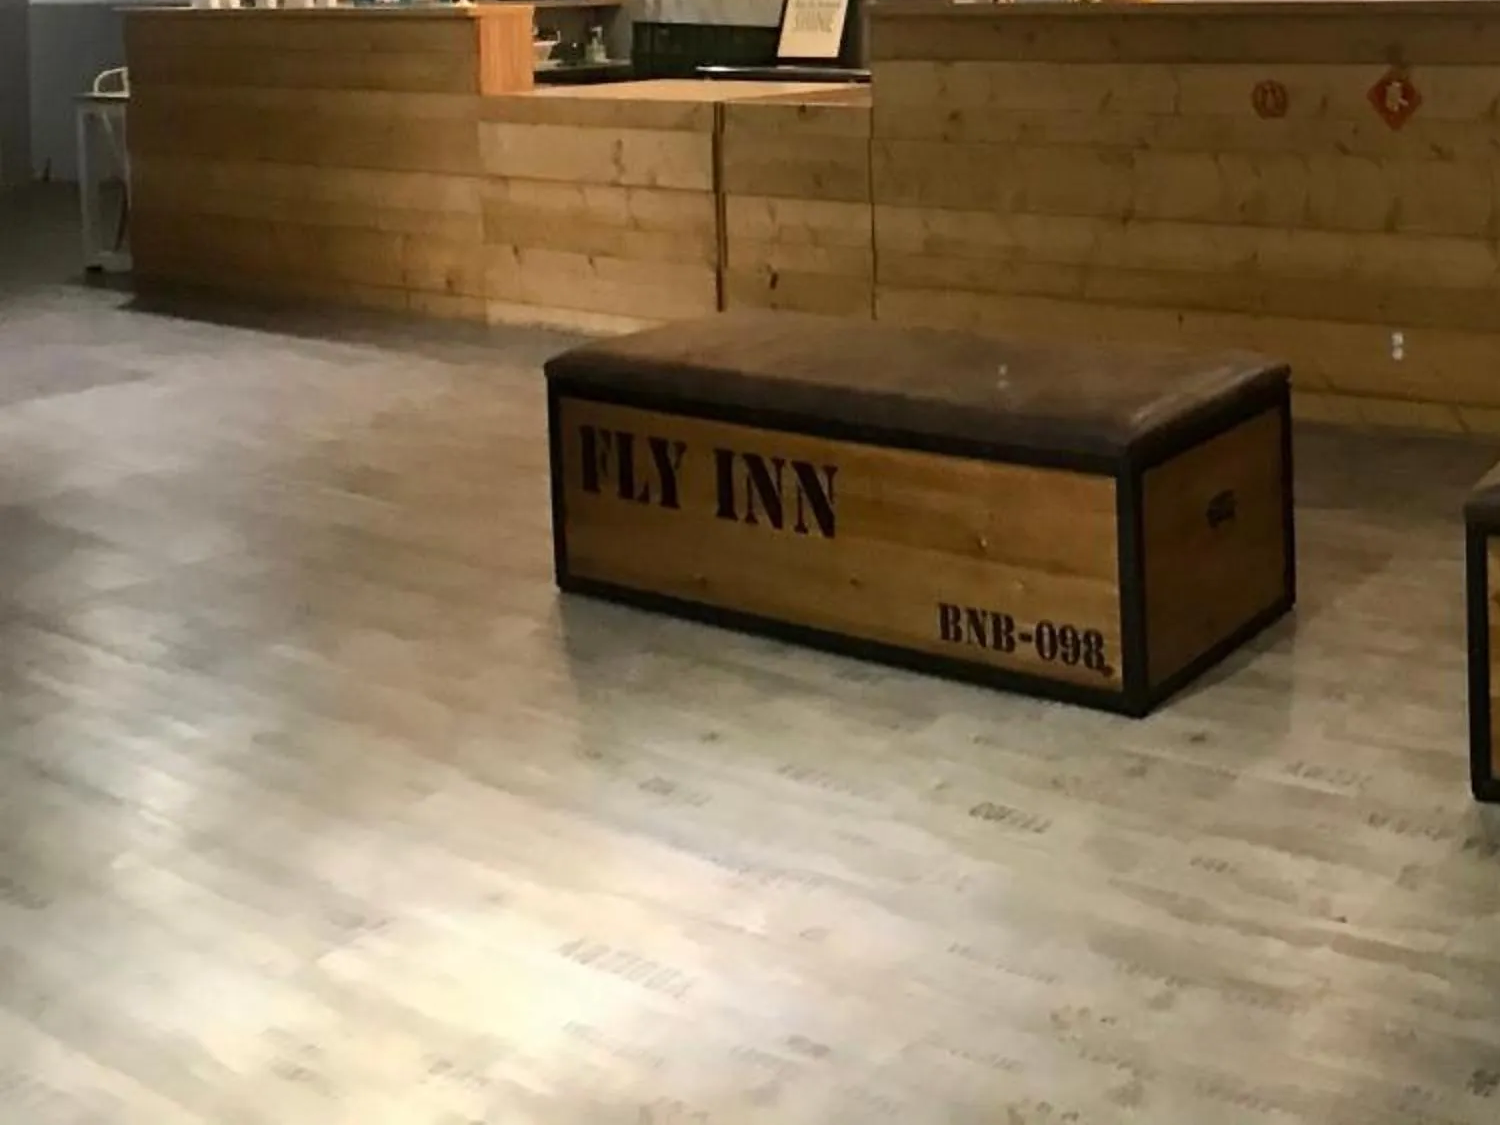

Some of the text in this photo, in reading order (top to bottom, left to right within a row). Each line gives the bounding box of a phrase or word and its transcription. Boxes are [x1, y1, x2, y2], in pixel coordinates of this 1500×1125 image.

[579, 425, 838, 539] FLY INN
[937, 602, 1107, 671] BNB-098
